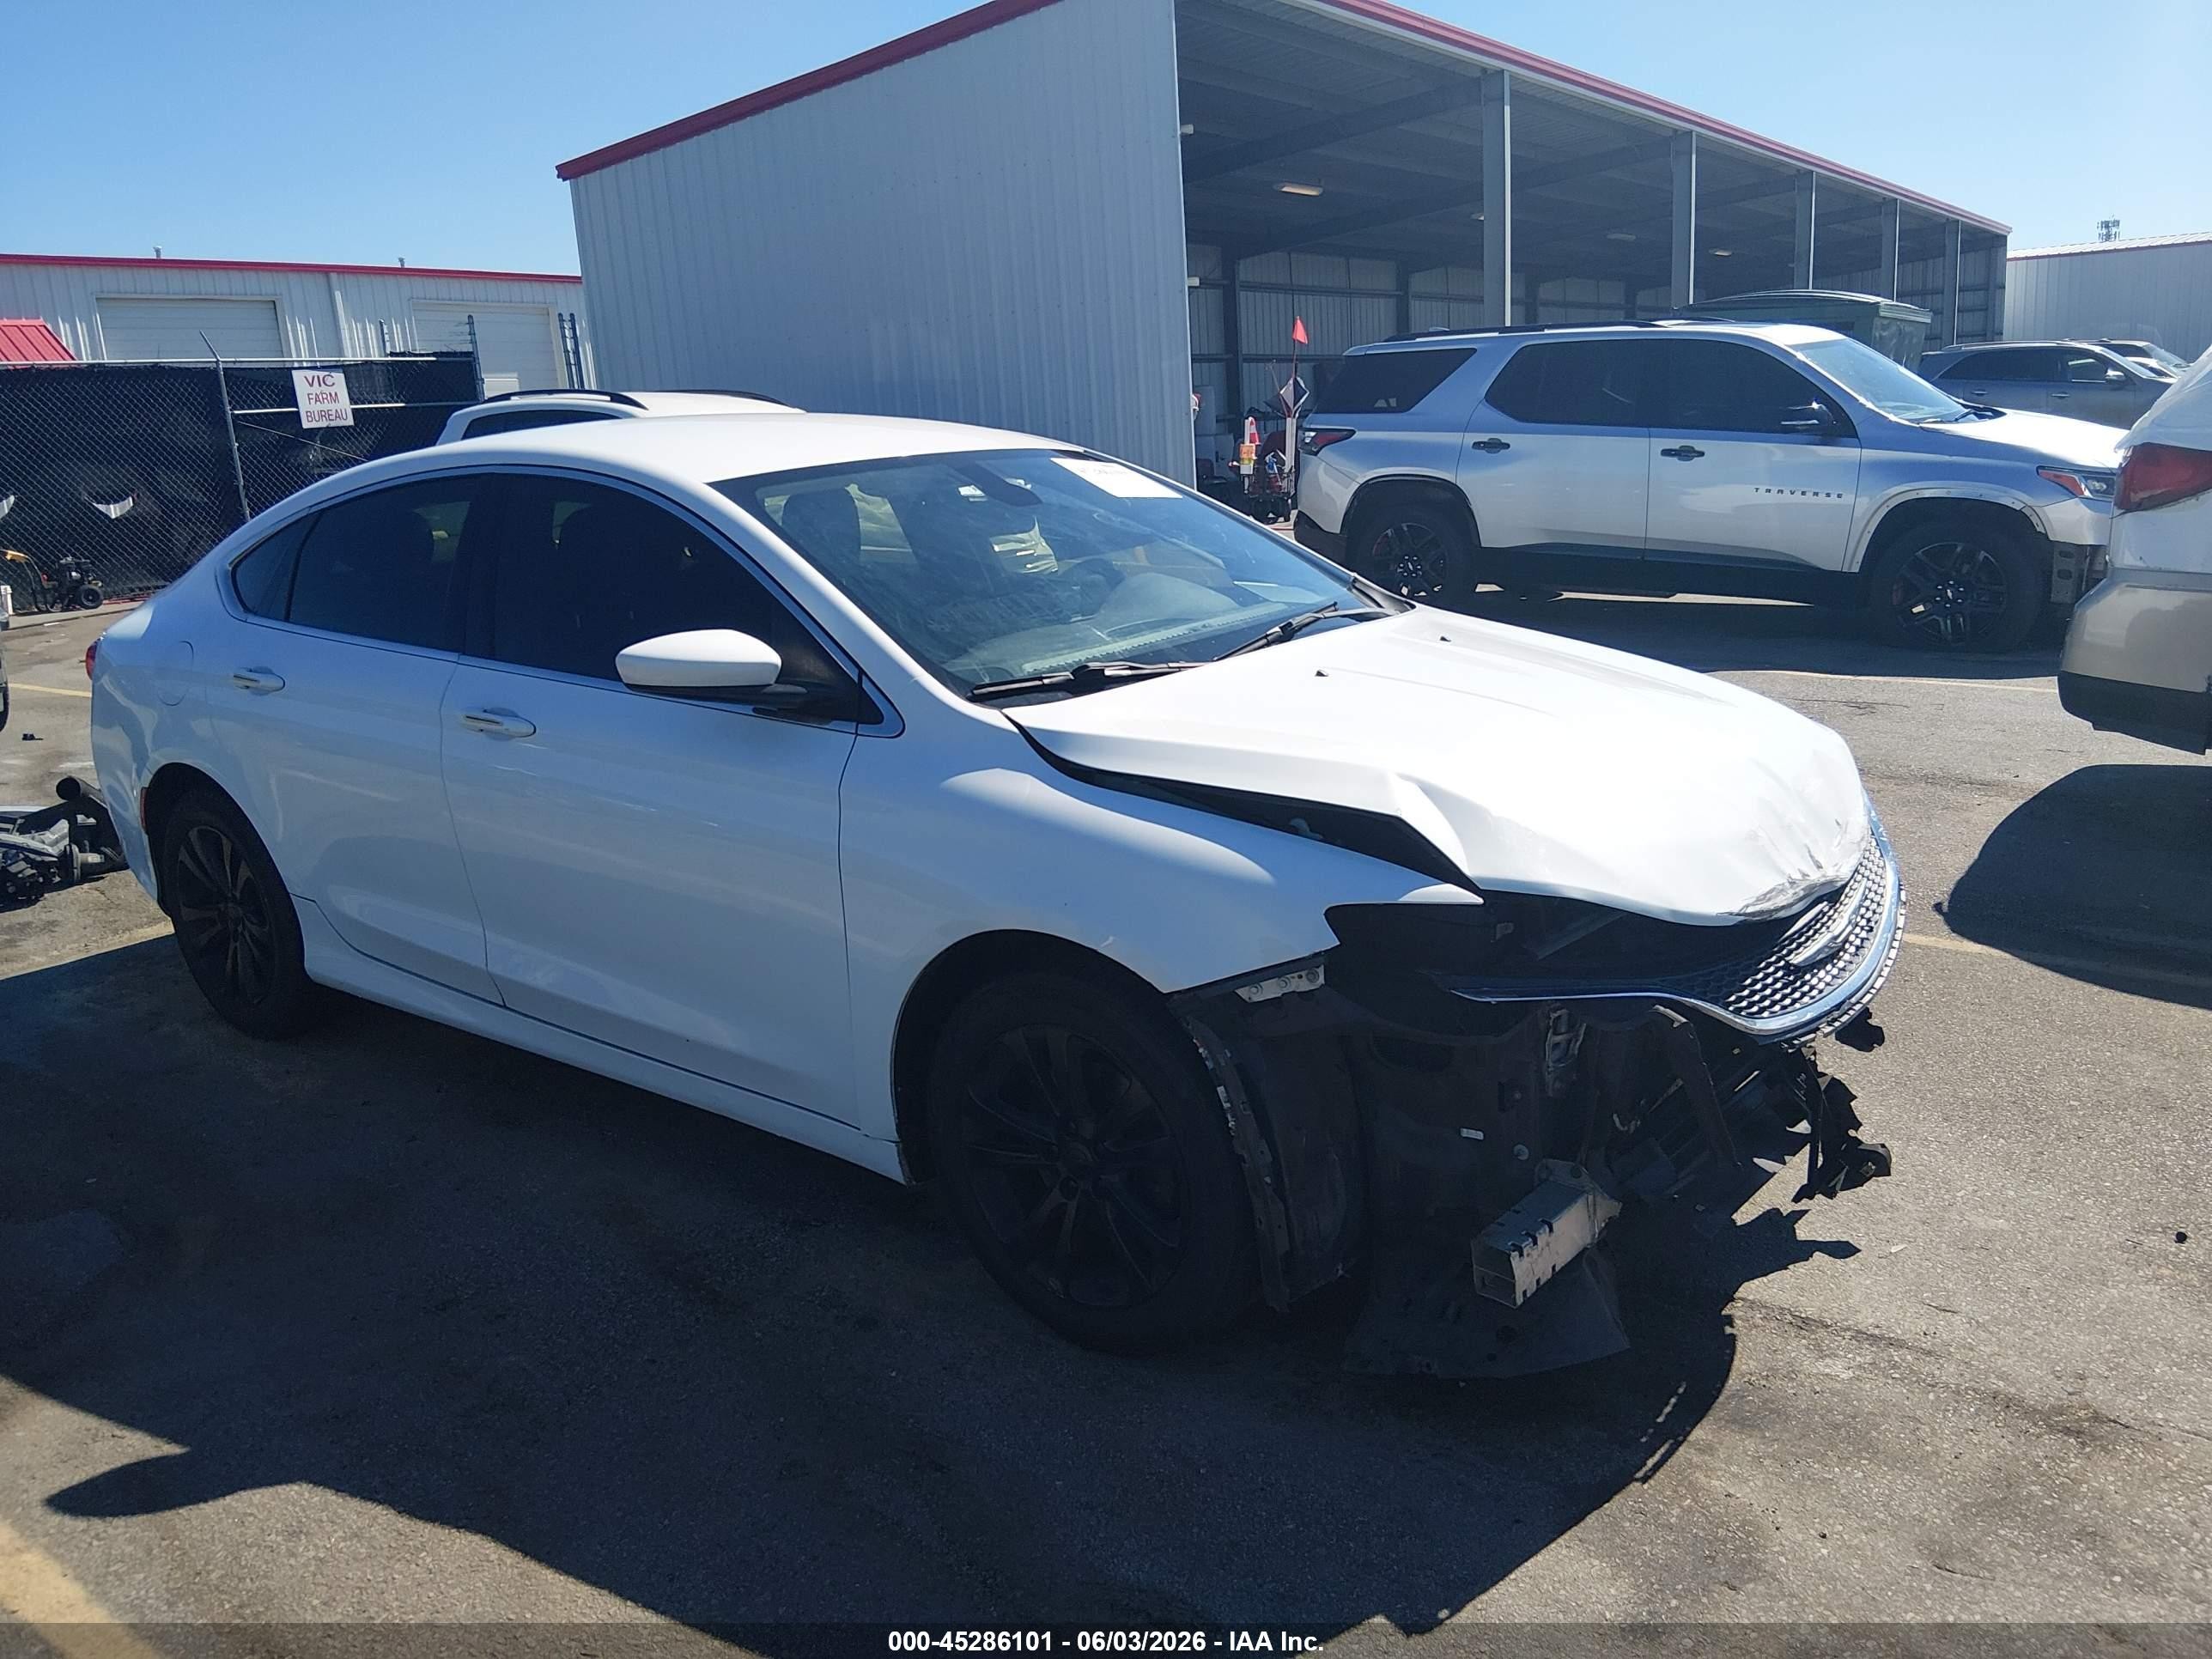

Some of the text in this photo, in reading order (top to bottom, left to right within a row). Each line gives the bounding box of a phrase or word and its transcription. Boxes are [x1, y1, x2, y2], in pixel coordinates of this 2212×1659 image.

[304, 374, 336, 387] VIC
[307, 392, 340, 404] FARM
[306, 409, 348, 422] BUREAU
[1754, 487, 1844, 499] TRAVERSE
